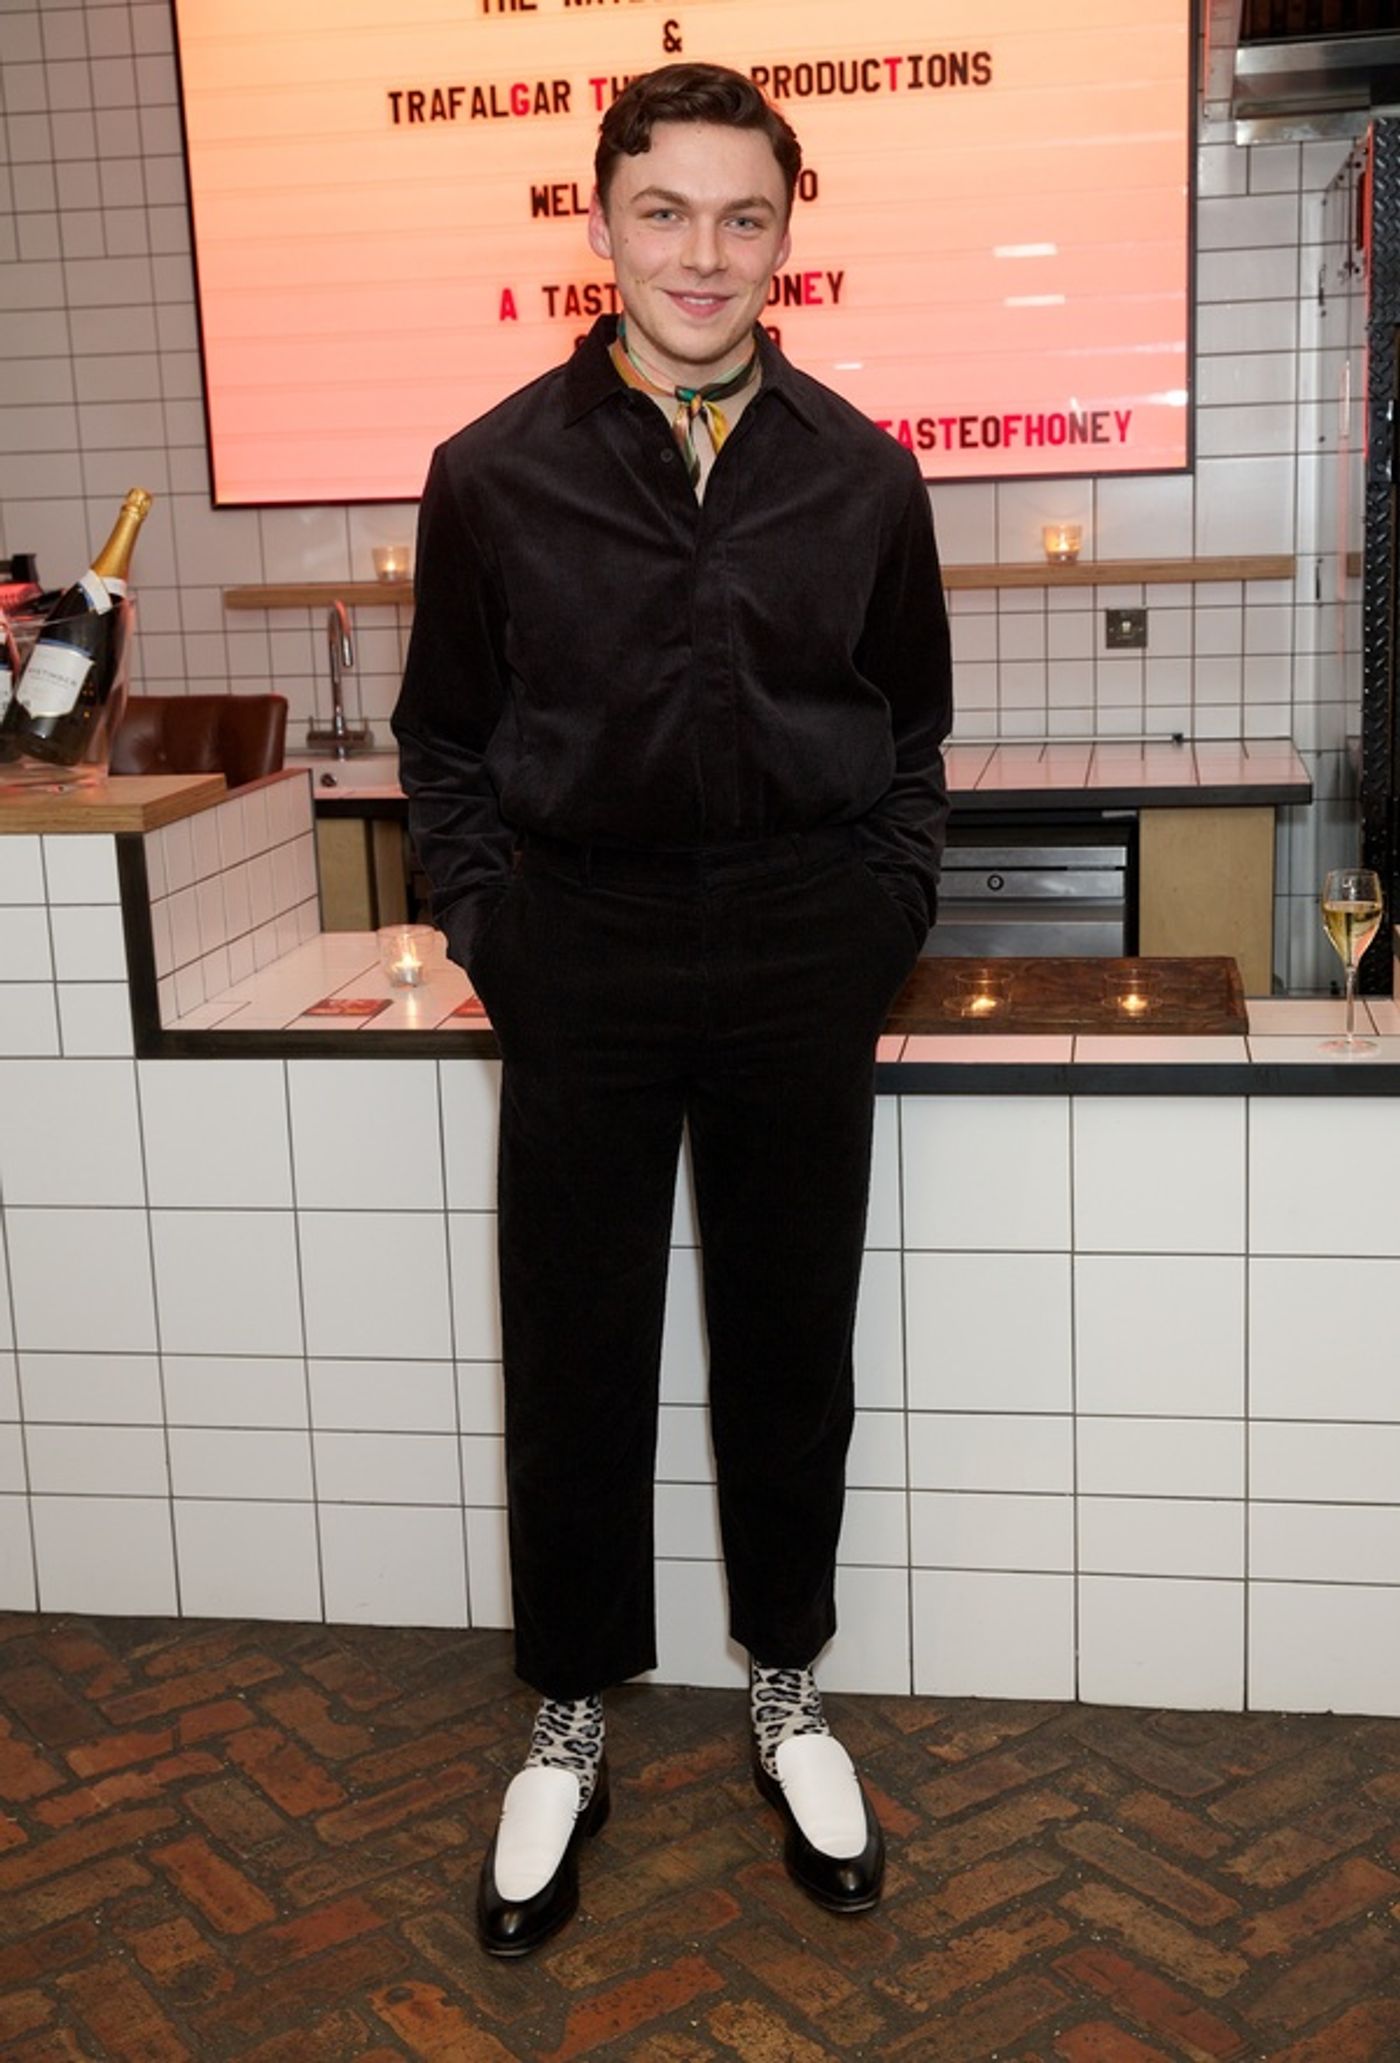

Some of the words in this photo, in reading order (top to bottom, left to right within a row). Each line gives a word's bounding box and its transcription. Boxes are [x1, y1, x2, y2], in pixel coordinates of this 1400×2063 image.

[663, 19, 683, 53] &
[387, 79, 571, 124] TRAFALGAR
[751, 51, 993, 99] PRODUCTIONS
[499, 287, 518, 321] A
[541, 282, 621, 318] TAST
[766, 270, 844, 307] ONEY
[874, 410, 1133, 451] ASTEOFHONEY
